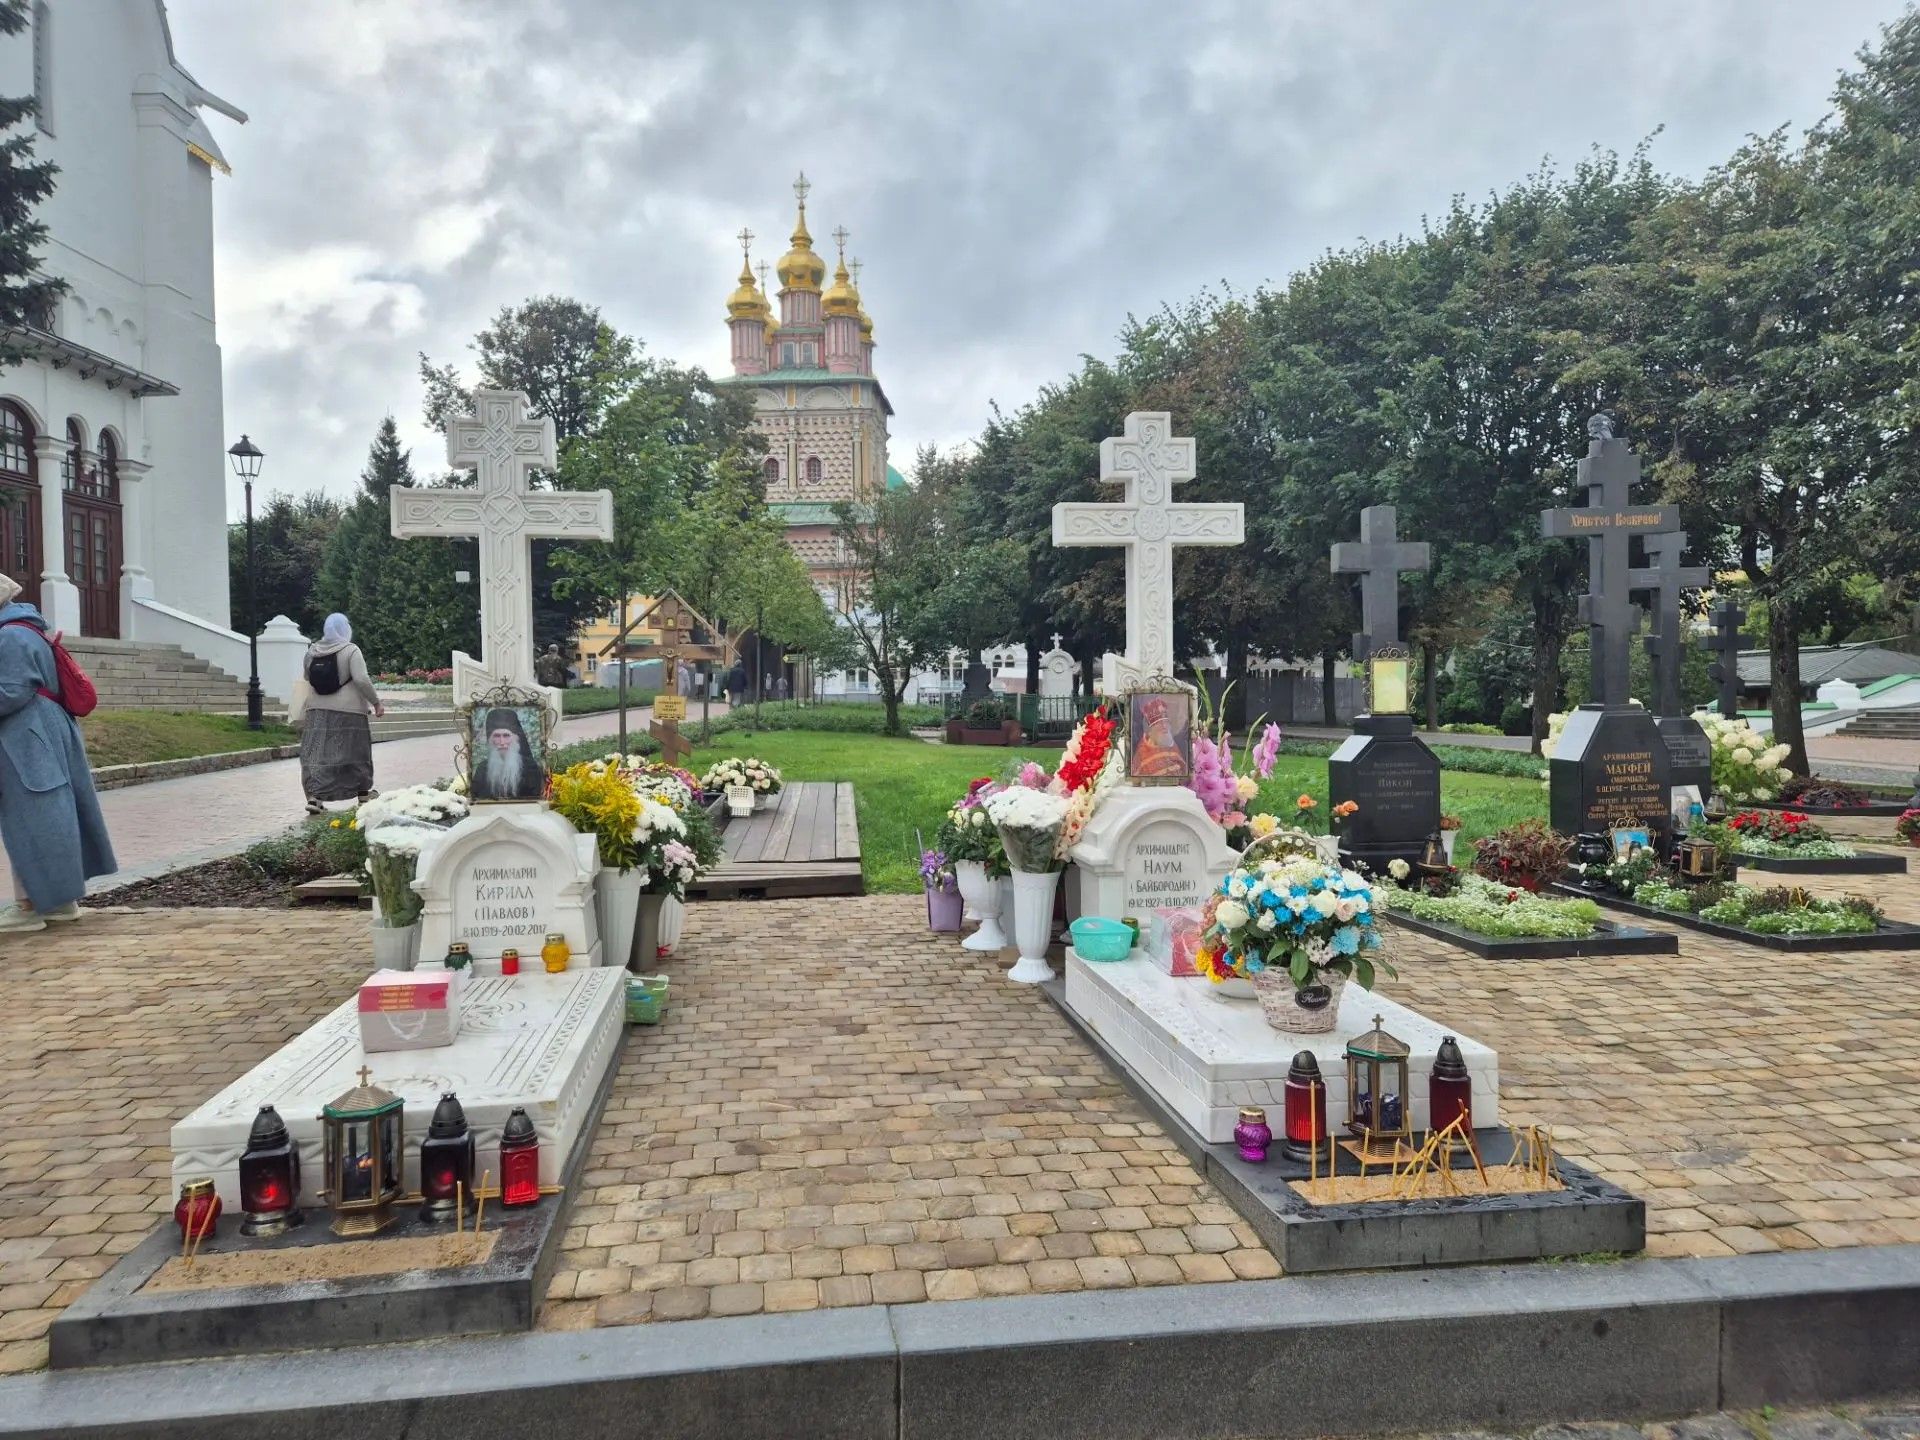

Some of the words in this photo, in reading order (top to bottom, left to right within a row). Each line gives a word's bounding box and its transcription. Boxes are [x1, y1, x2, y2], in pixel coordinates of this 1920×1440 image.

[1606, 761, 1651, 775] МАТФЕЙ
[1136, 844, 1190, 855] АРХИМАНДРИТ
[1144, 859, 1182, 875] НАУМ
[476, 884, 534, 901] КИРИЛЛ
